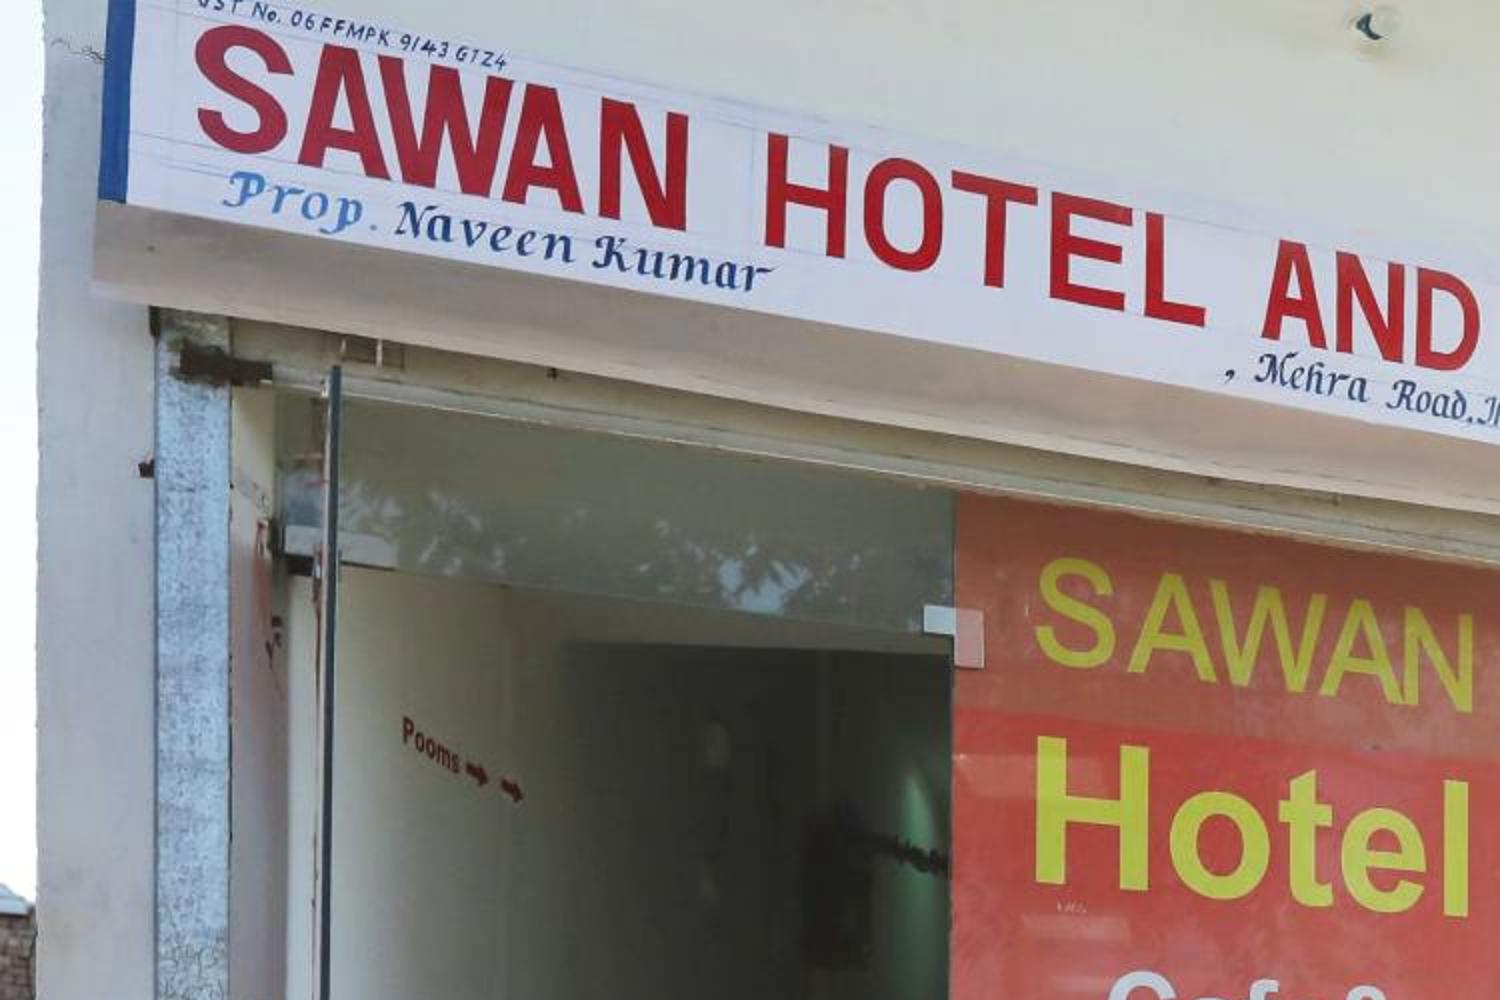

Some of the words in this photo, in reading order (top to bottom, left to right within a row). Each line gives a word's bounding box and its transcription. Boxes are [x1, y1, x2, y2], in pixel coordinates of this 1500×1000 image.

[251, 1, 281, 24] No.
[195, 25, 689, 232] SAWAN
[764, 132, 1207, 328] HOTEL
[1261, 239, 1481, 372] AND
[222, 169, 378, 235] Prop.
[394, 200, 577, 265] Naveen
[592, 233, 773, 293] Kumar
[1254, 351, 1370, 403] Mehra
[1034, 557, 1474, 713] SAWAN
[1035, 735, 1468, 918] Hotel
